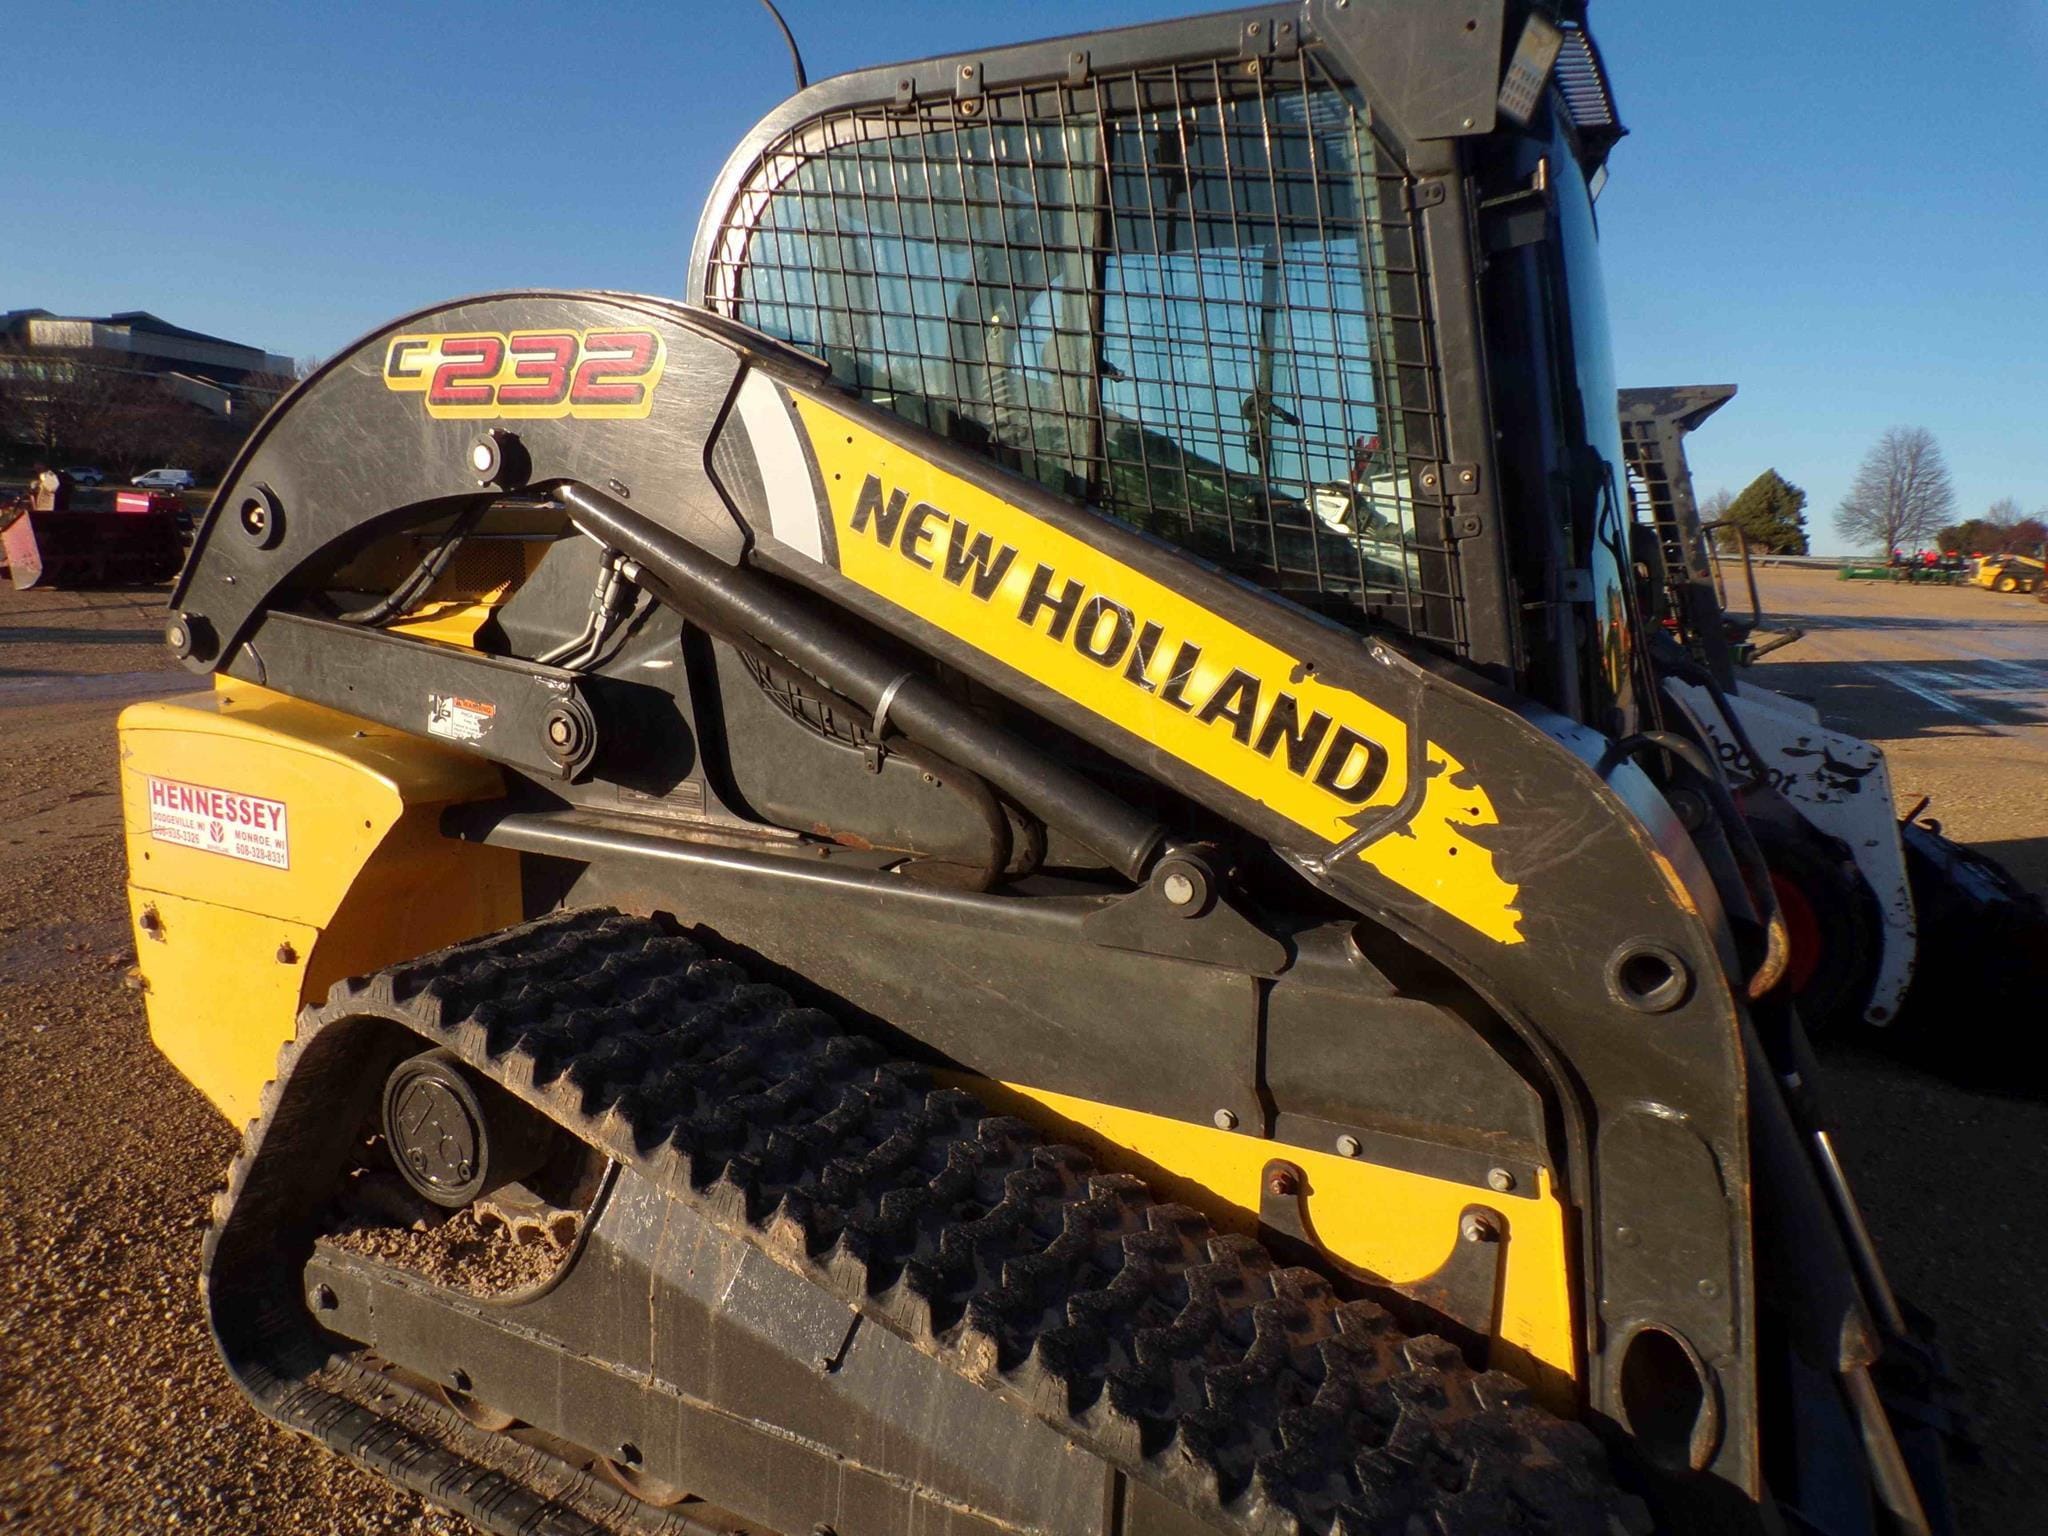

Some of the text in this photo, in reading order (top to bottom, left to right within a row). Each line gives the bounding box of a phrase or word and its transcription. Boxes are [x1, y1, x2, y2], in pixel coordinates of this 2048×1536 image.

[387, 331, 659, 406] C232
[849, 473, 1390, 806] NEW HOLLAND
[152, 780, 281, 832] HENNESSEY
[274, 838, 286, 850] WI
